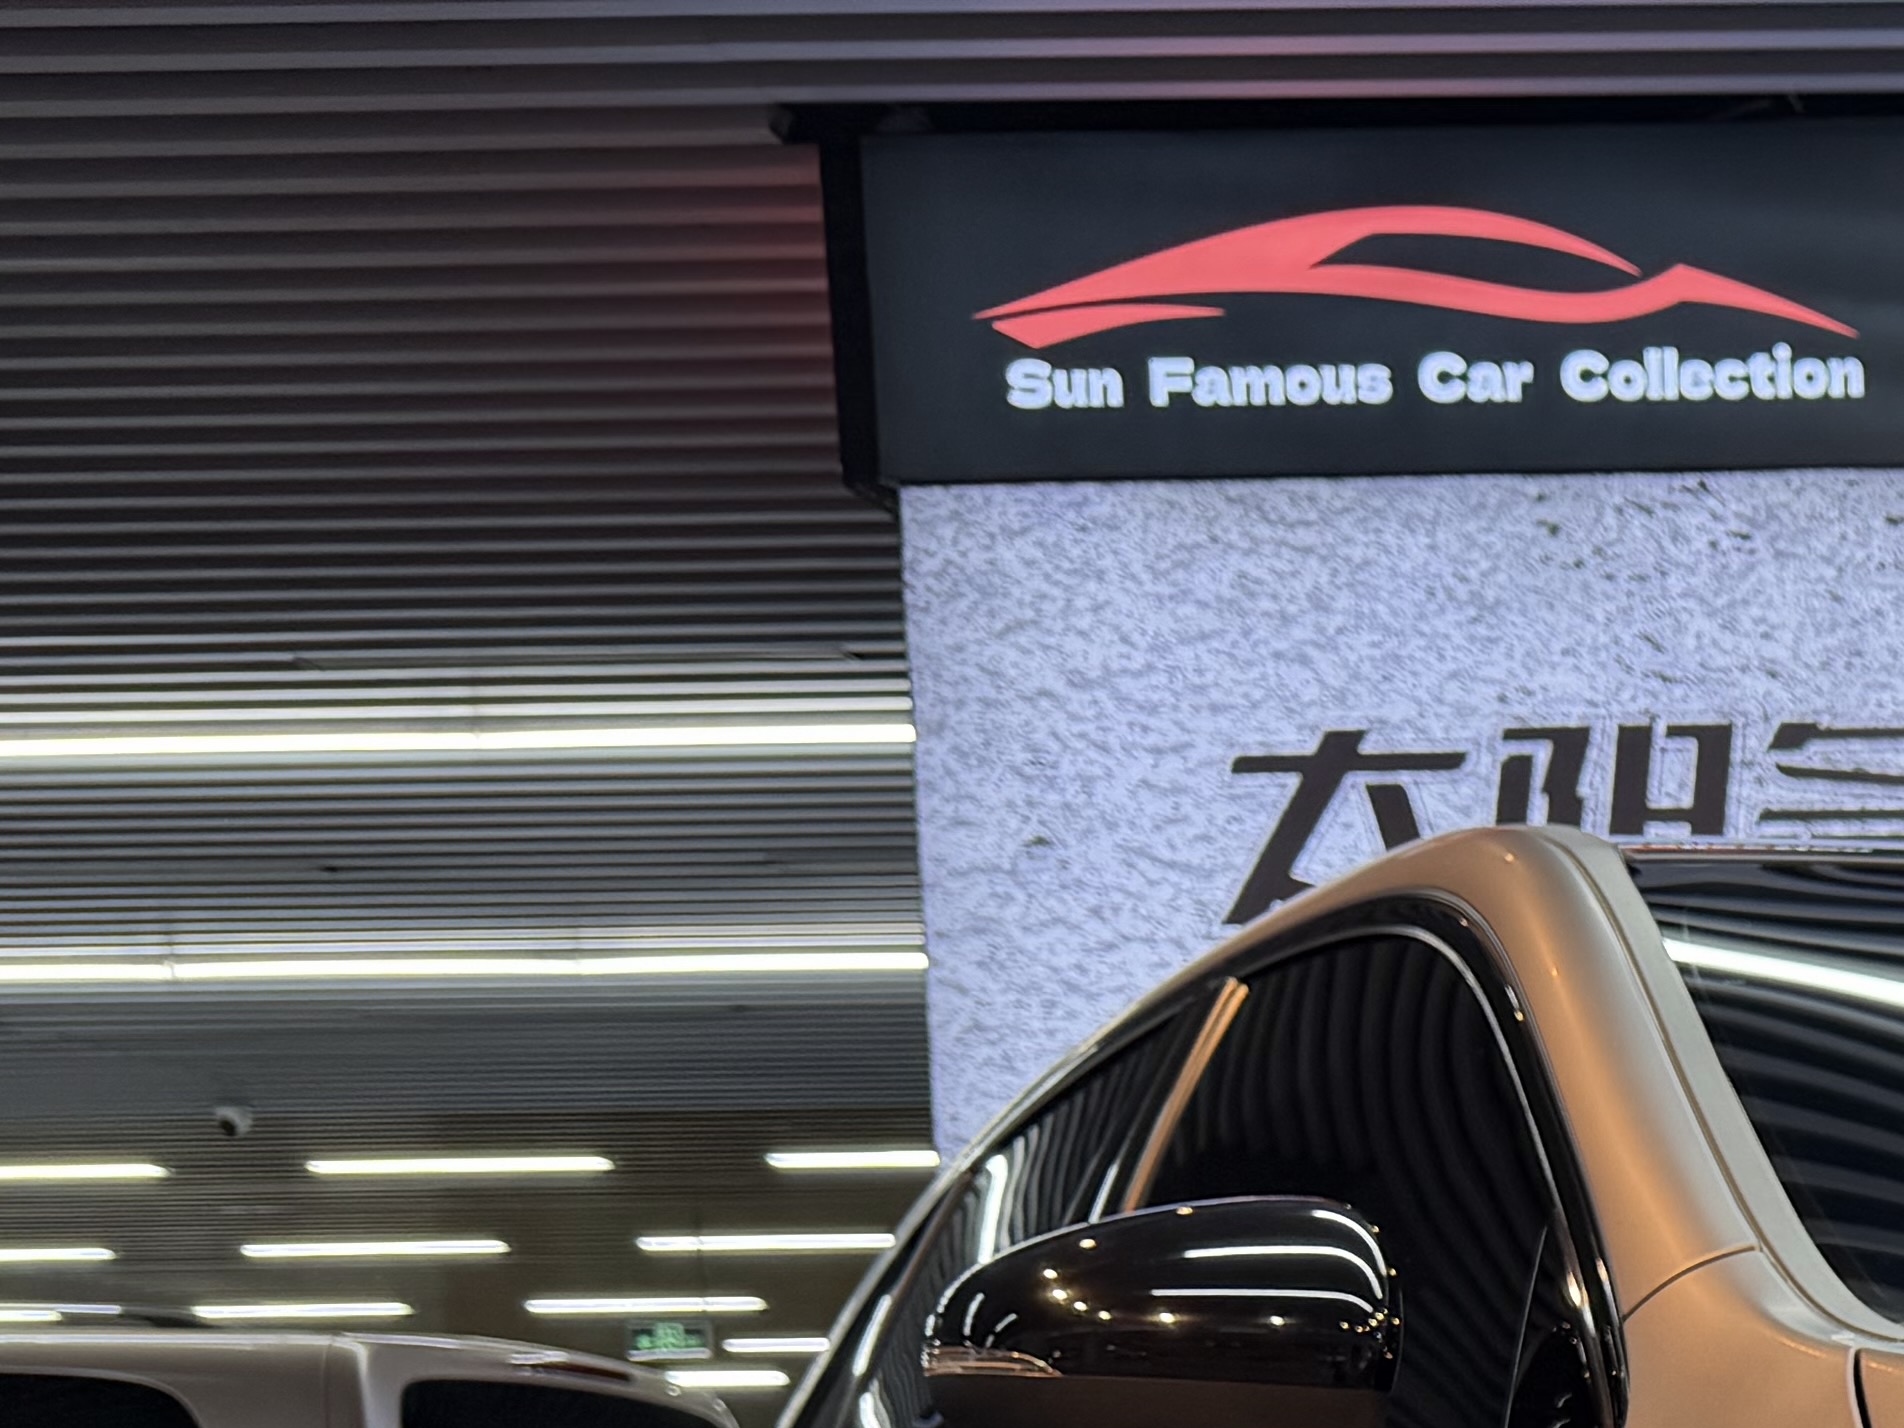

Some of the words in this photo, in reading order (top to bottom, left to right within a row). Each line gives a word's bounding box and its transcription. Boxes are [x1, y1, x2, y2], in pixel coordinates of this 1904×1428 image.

[1005, 357, 1123, 409] Sun
[1148, 352, 1394, 407] Famous
[1417, 350, 1533, 404] Car
[1559, 342, 1866, 402] Collection
